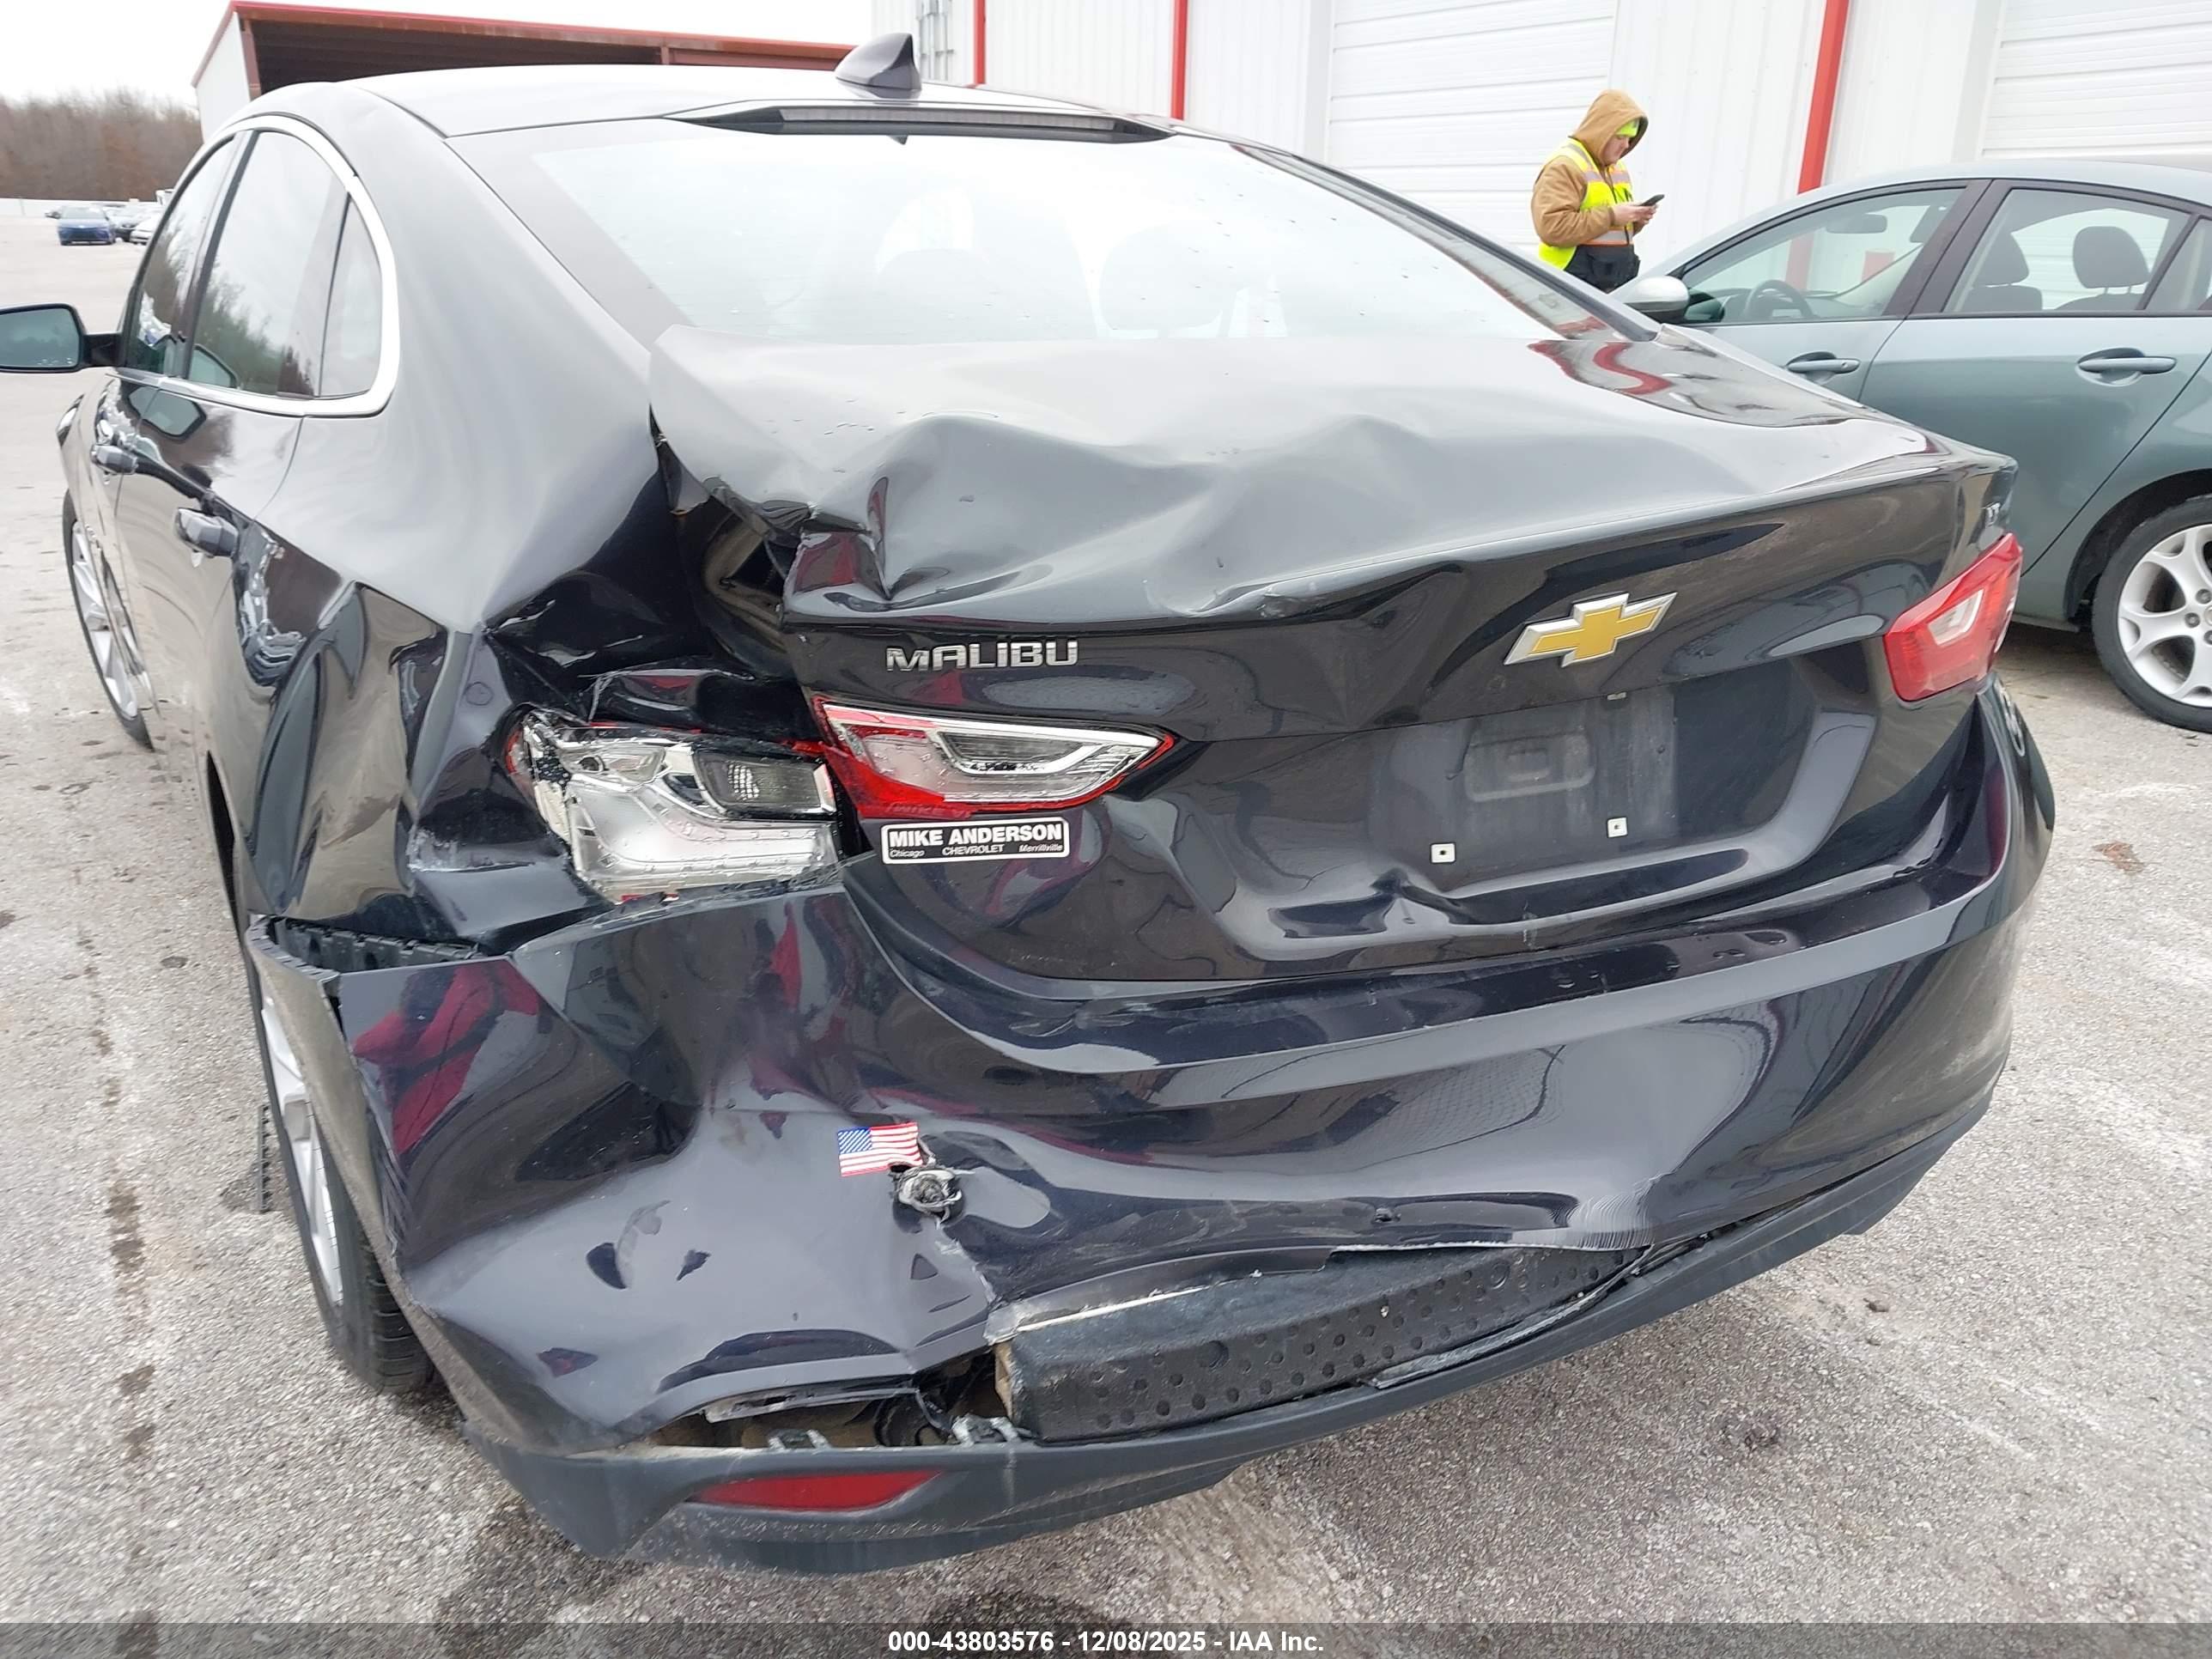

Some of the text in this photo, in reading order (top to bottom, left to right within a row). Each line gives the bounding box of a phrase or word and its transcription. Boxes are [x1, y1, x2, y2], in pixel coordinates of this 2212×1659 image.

[885, 640, 1079, 672] MALIBU
[889, 823, 1062, 848] MIKE ANDERSON
[889, 842, 1064, 859] Chicago CHEVROLET Merrillville
